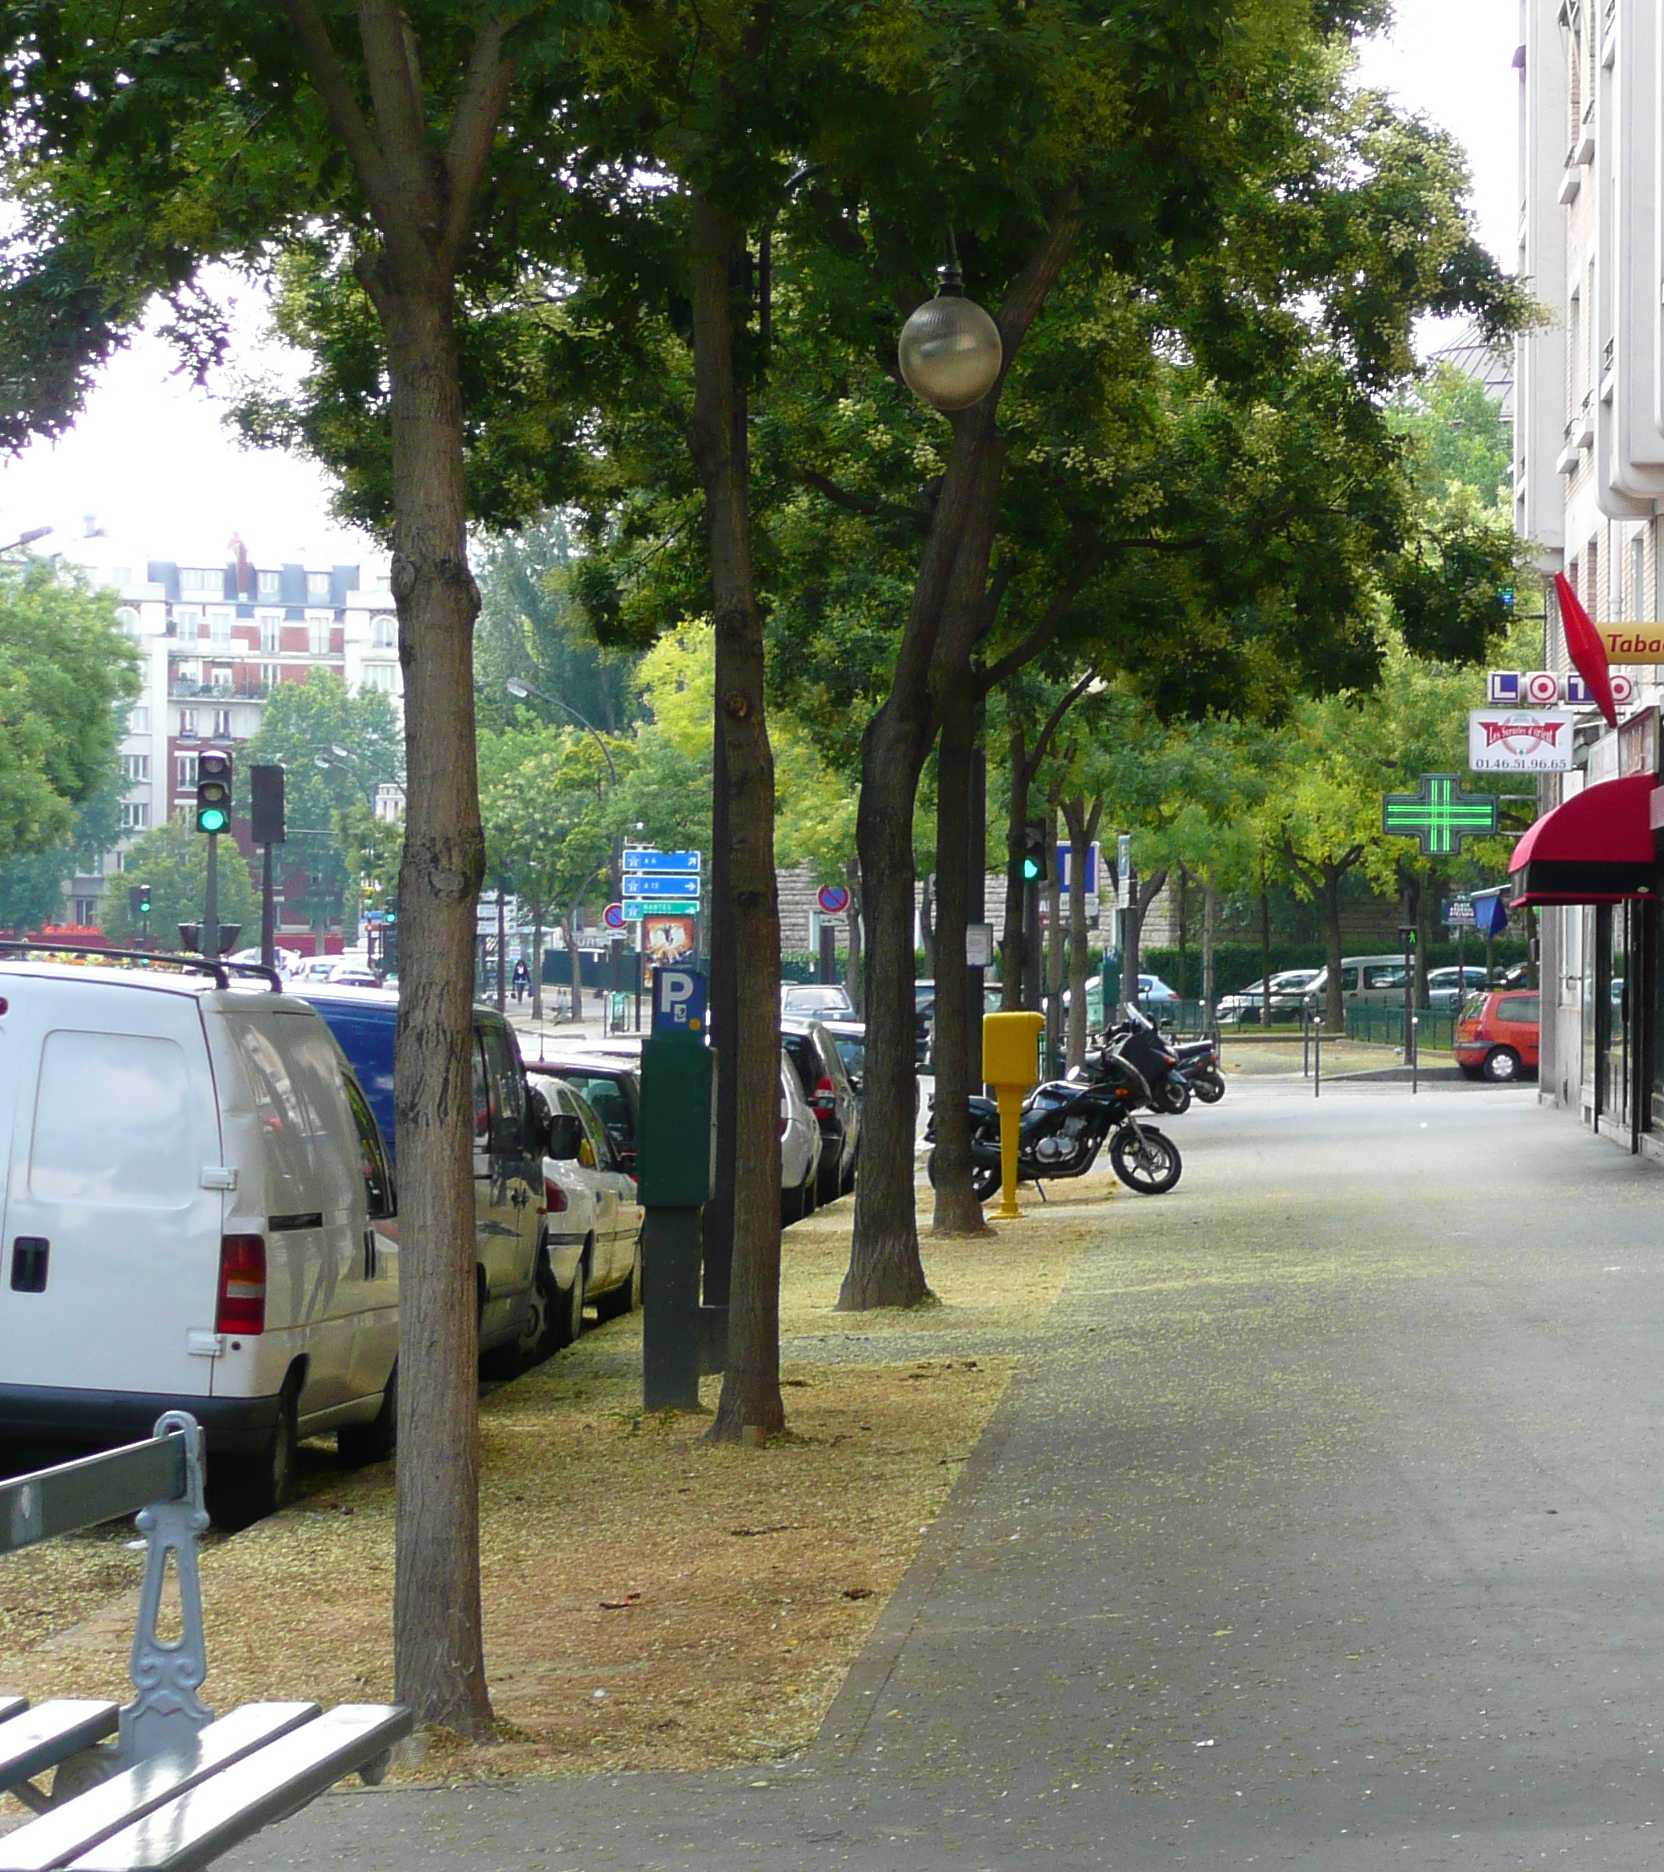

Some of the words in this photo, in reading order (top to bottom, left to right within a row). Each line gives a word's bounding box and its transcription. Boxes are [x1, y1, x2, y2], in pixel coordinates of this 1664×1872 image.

[1492, 674, 1633, 702] LOTO
[1488, 726, 1501, 744] Les
[1475, 759, 1567, 769] 01.46.51.96.65
[661, 972, 694, 1013] P
